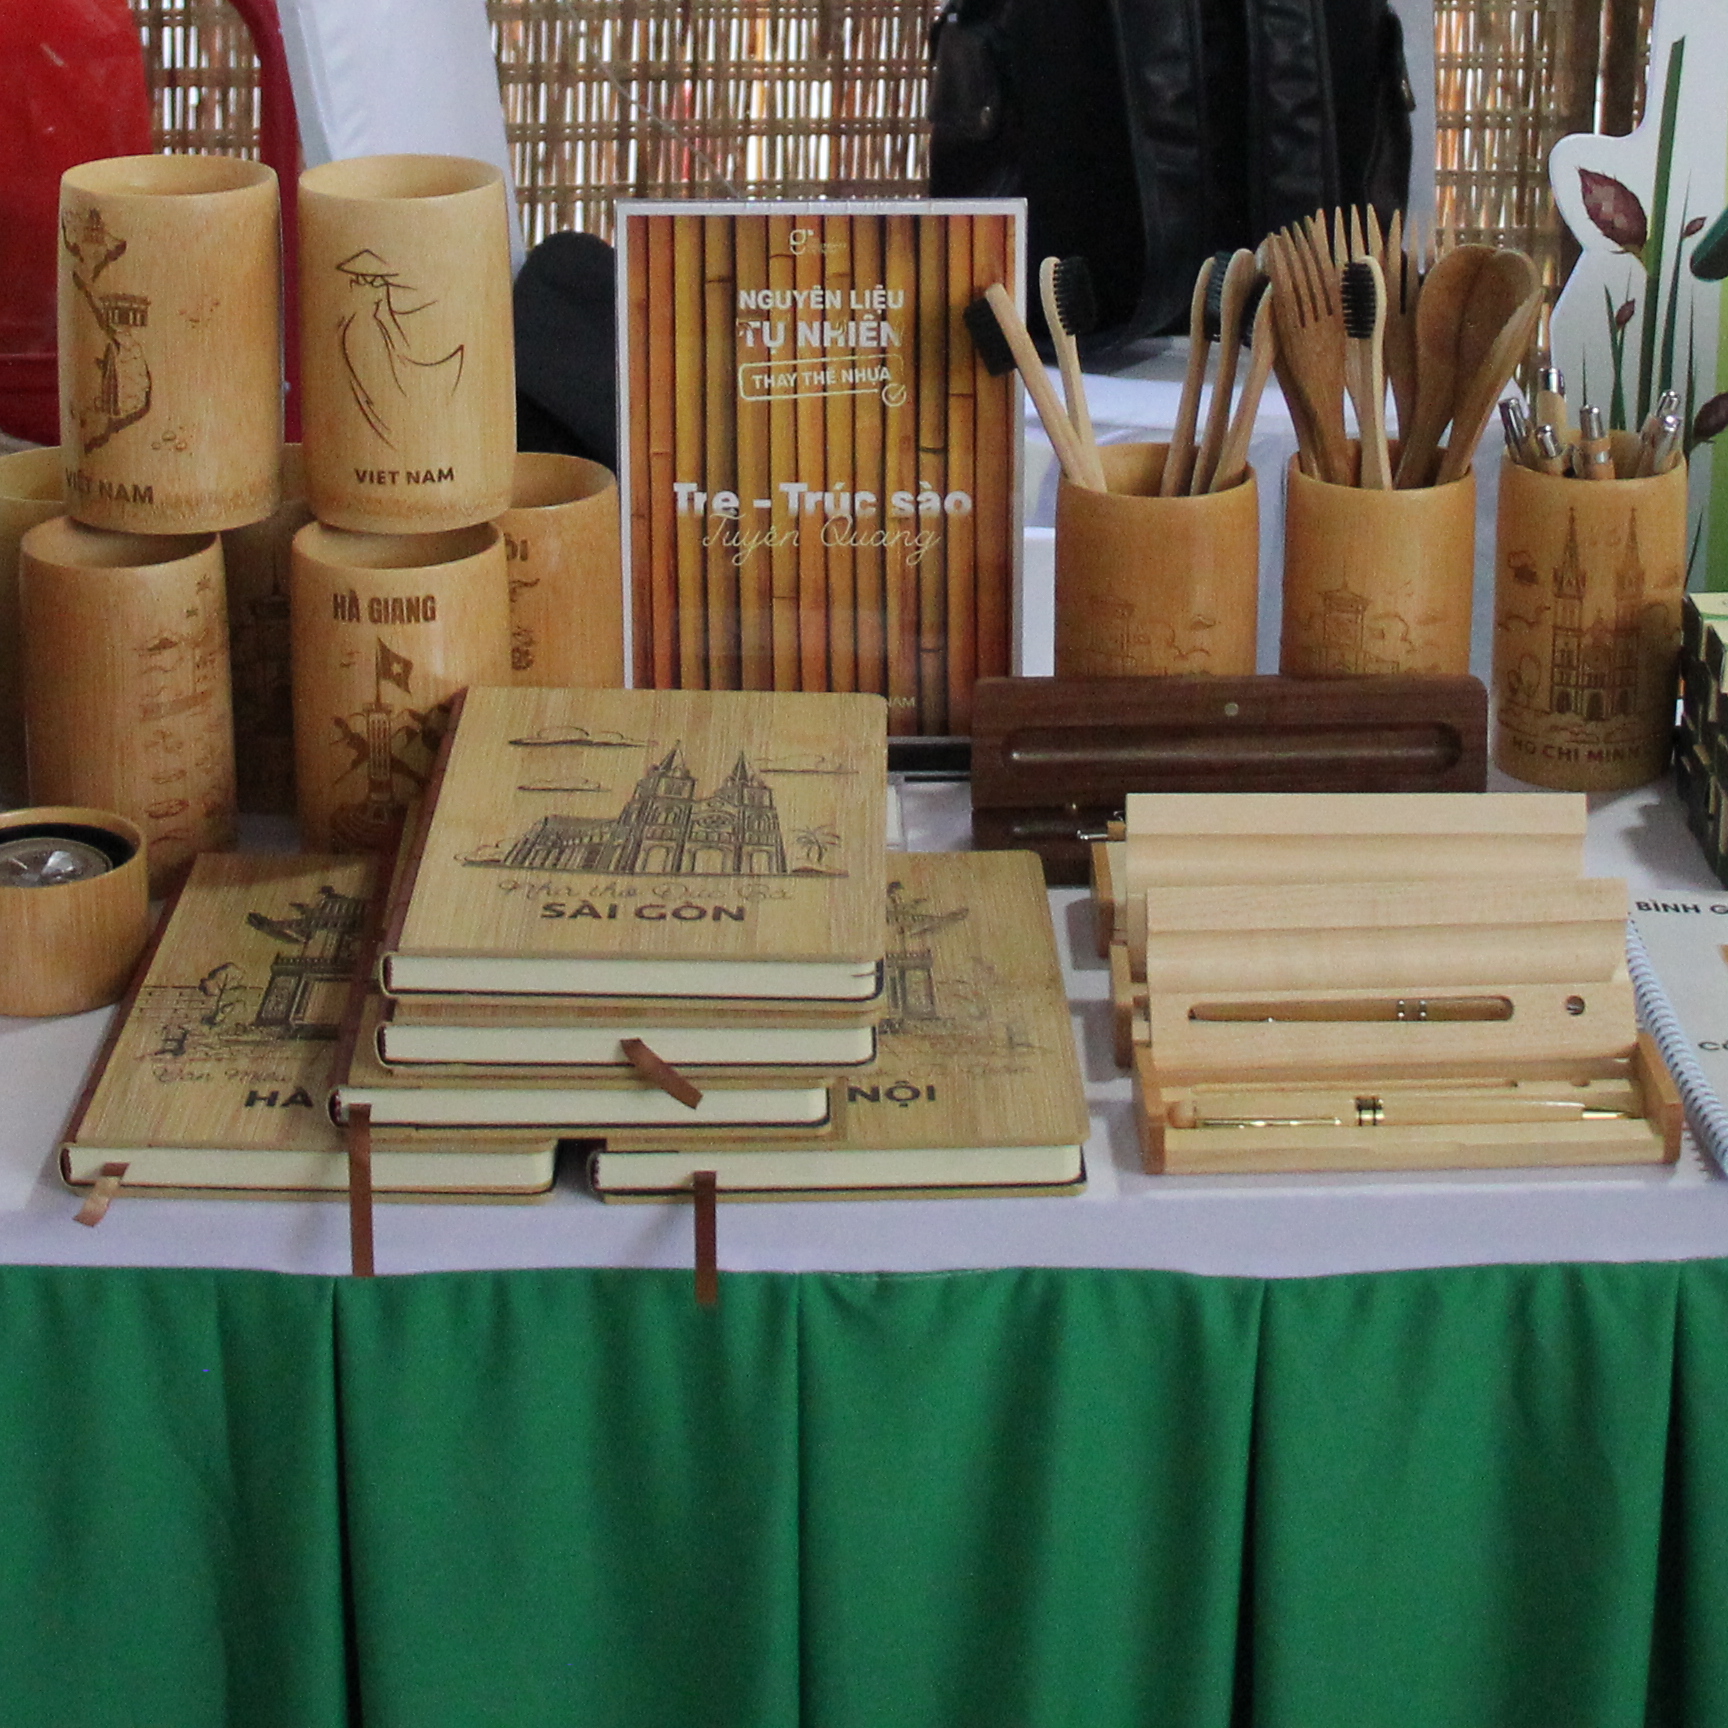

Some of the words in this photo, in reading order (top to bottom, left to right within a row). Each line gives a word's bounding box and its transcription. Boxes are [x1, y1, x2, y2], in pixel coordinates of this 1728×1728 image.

[739, 285, 842, 310] NGUYÊN
[849, 285, 905, 315] LIỆU
[797, 313, 903, 348] NHIÊN
[752, 373, 797, 390] THAY
[406, 466, 455, 485] NAM
[98, 478, 154, 505] NAM
[673, 482, 740, 516] Tre
[779, 481, 877, 516] Trúc
[891, 481, 972, 516] sào
[820, 512, 942, 566] Quang
[333, 588, 361, 623] HÀ
[368, 594, 437, 624] GIANG
[541, 899, 618, 920] SÀI
[635, 901, 746, 922] GÒN
[1636, 898, 1702, 914] BÌNH
[847, 1080, 936, 1108] NỘI
